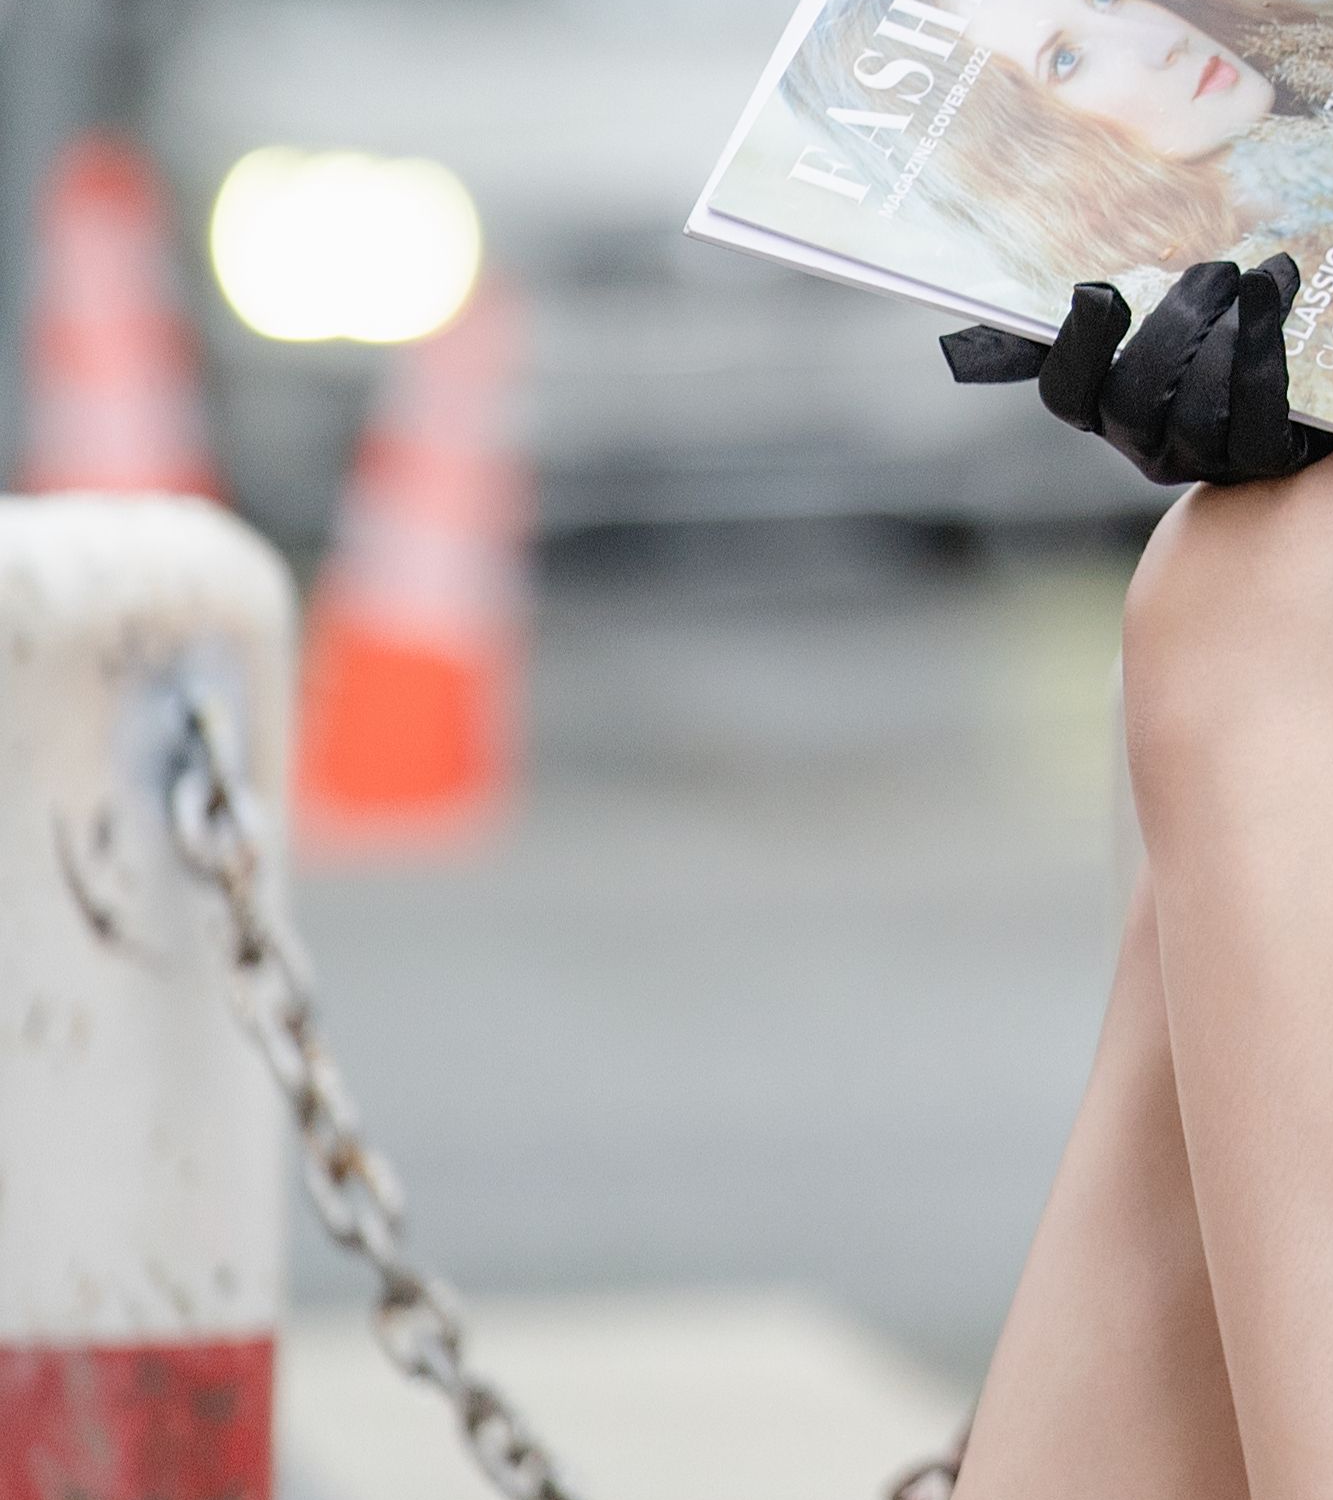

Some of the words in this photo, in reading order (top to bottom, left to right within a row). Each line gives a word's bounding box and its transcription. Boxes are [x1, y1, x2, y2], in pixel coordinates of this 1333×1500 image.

[879, 135, 938, 219] MAGAZINE
[928, 84, 967, 138] COVER
[958, 46, 992, 87] 2022
